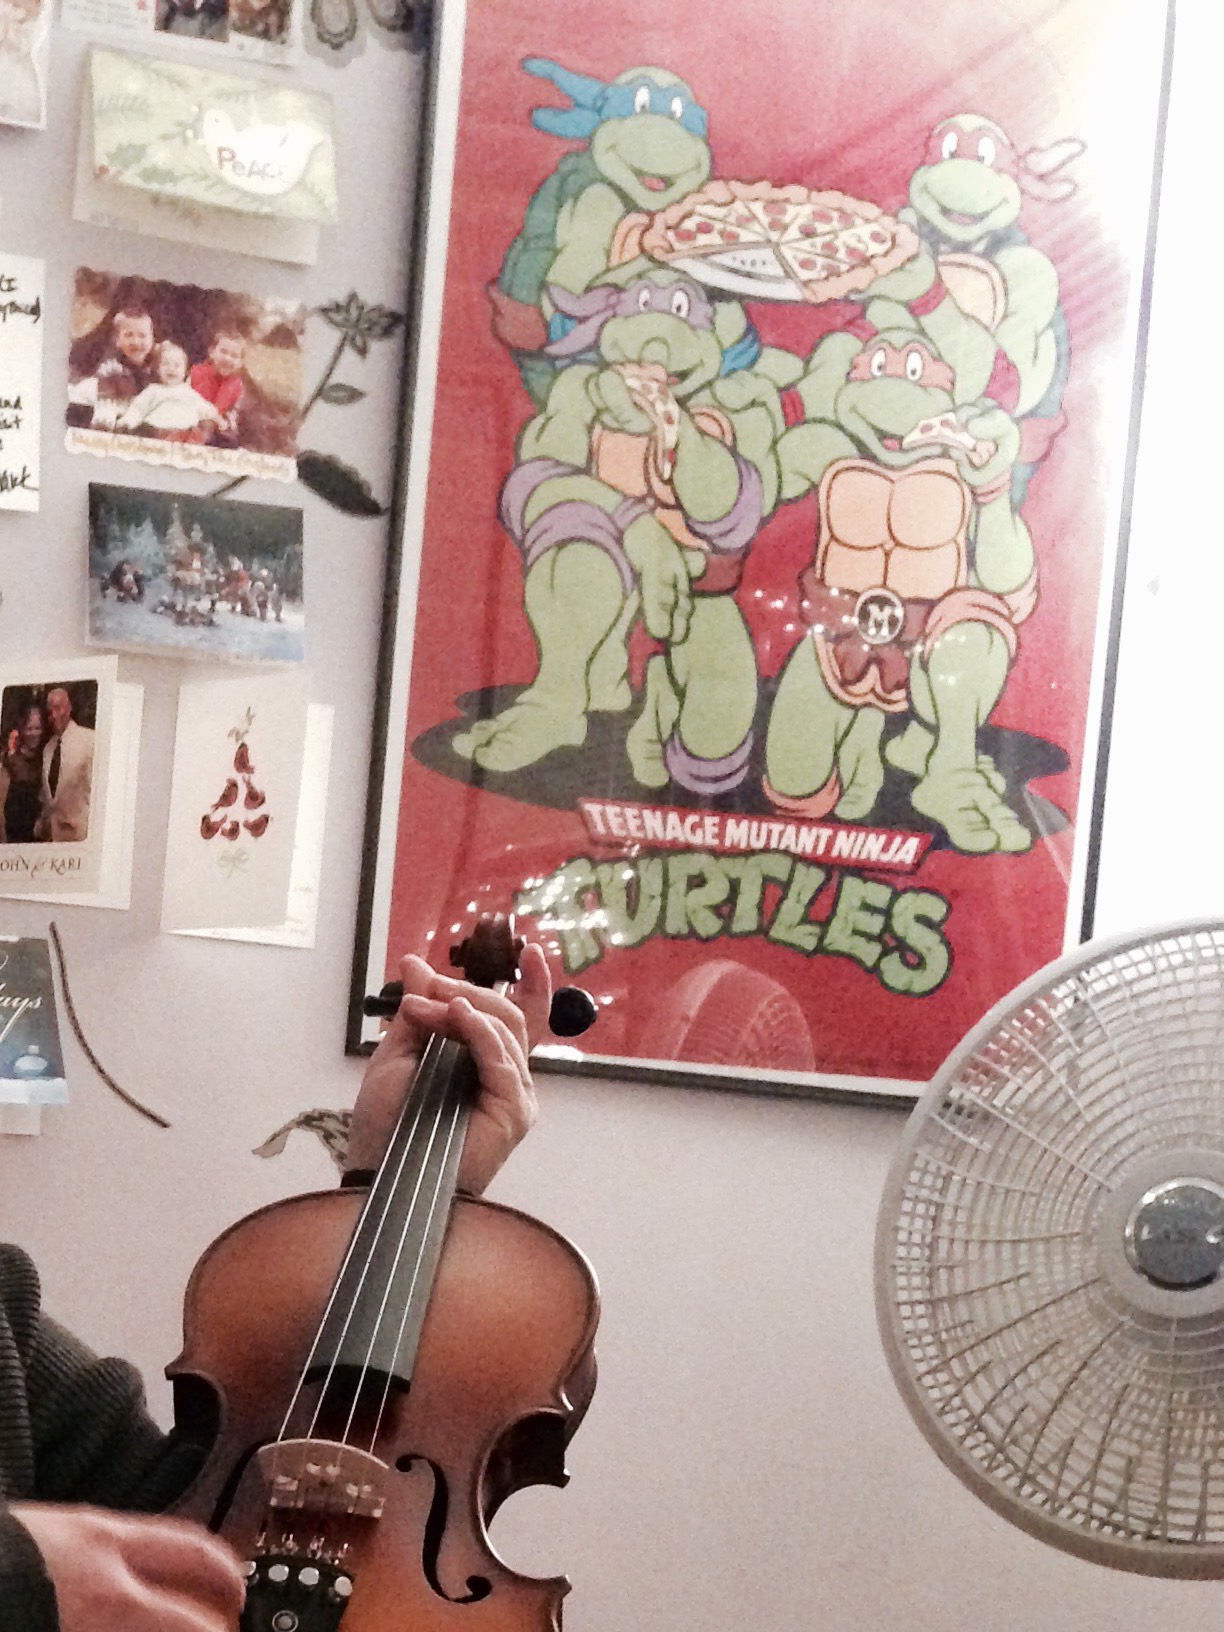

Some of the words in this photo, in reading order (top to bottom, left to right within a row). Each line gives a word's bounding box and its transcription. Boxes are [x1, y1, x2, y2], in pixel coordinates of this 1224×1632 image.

[584, 803, 720, 846] TEENAGE
[725, 817, 833, 856] MUTANT
[834, 831, 921, 864] NINJA
[518, 848, 953, 998] TURTLES
